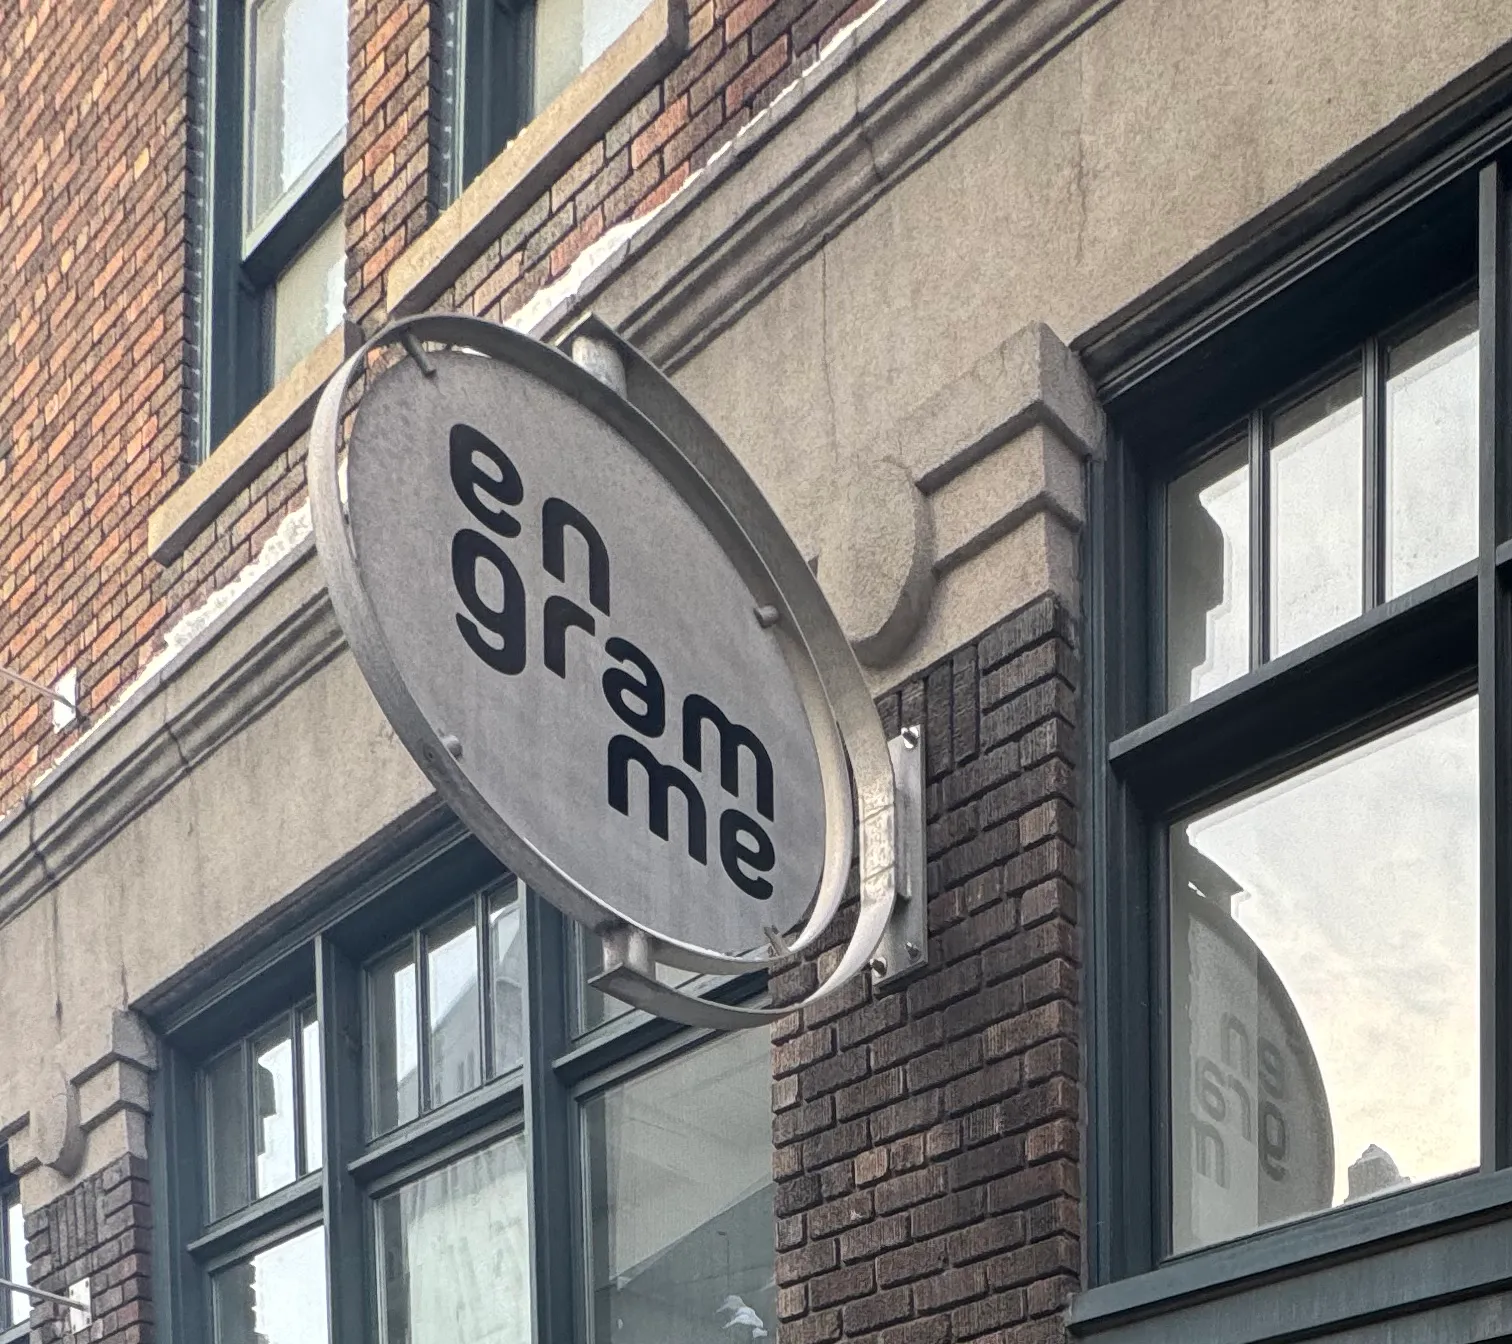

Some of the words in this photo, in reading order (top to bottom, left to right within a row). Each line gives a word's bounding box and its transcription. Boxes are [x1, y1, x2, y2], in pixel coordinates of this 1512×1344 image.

[449, 423, 611, 617] en
[450, 527, 775, 822] gram
[607, 733, 777, 900] me
